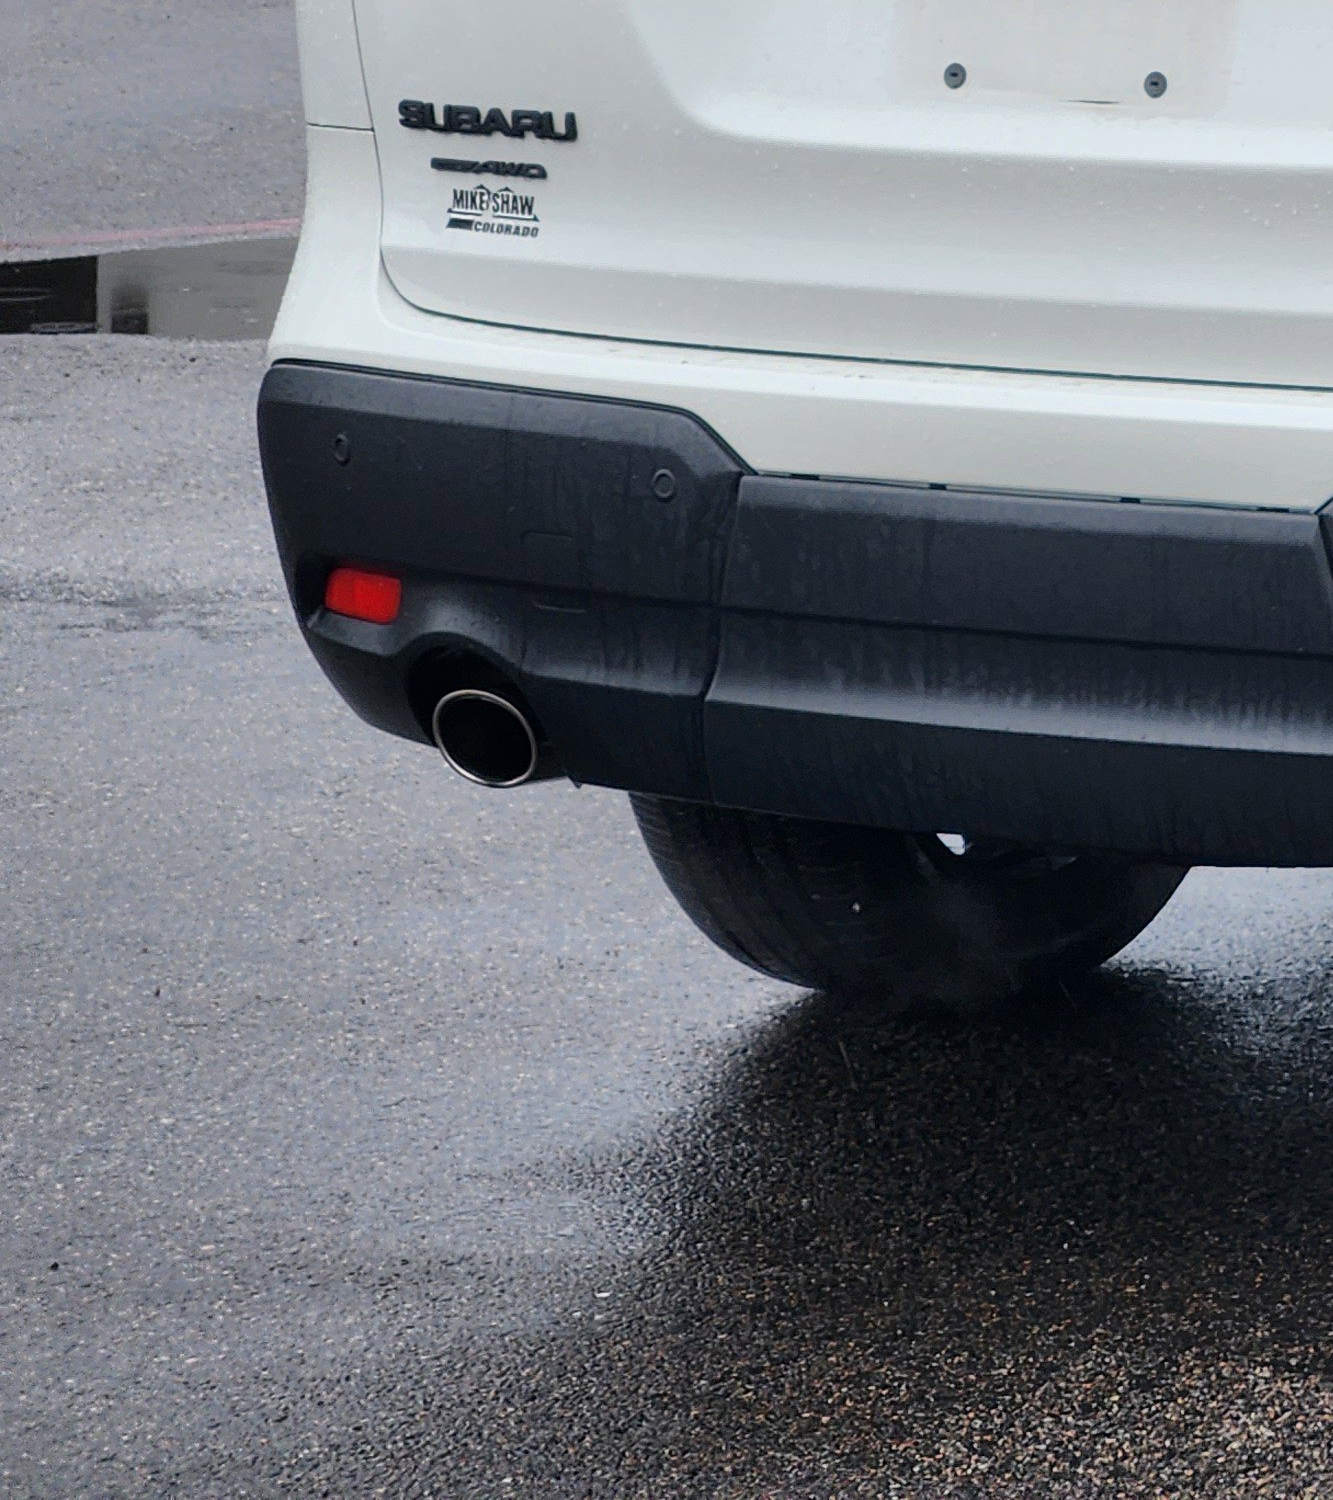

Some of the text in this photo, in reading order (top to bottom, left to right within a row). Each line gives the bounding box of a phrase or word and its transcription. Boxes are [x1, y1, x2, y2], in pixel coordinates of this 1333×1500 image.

[398, 98, 578, 142] SUBARU
[452, 188, 535, 216] MIKE SHAW
[473, 220, 540, 238] COLORADO
